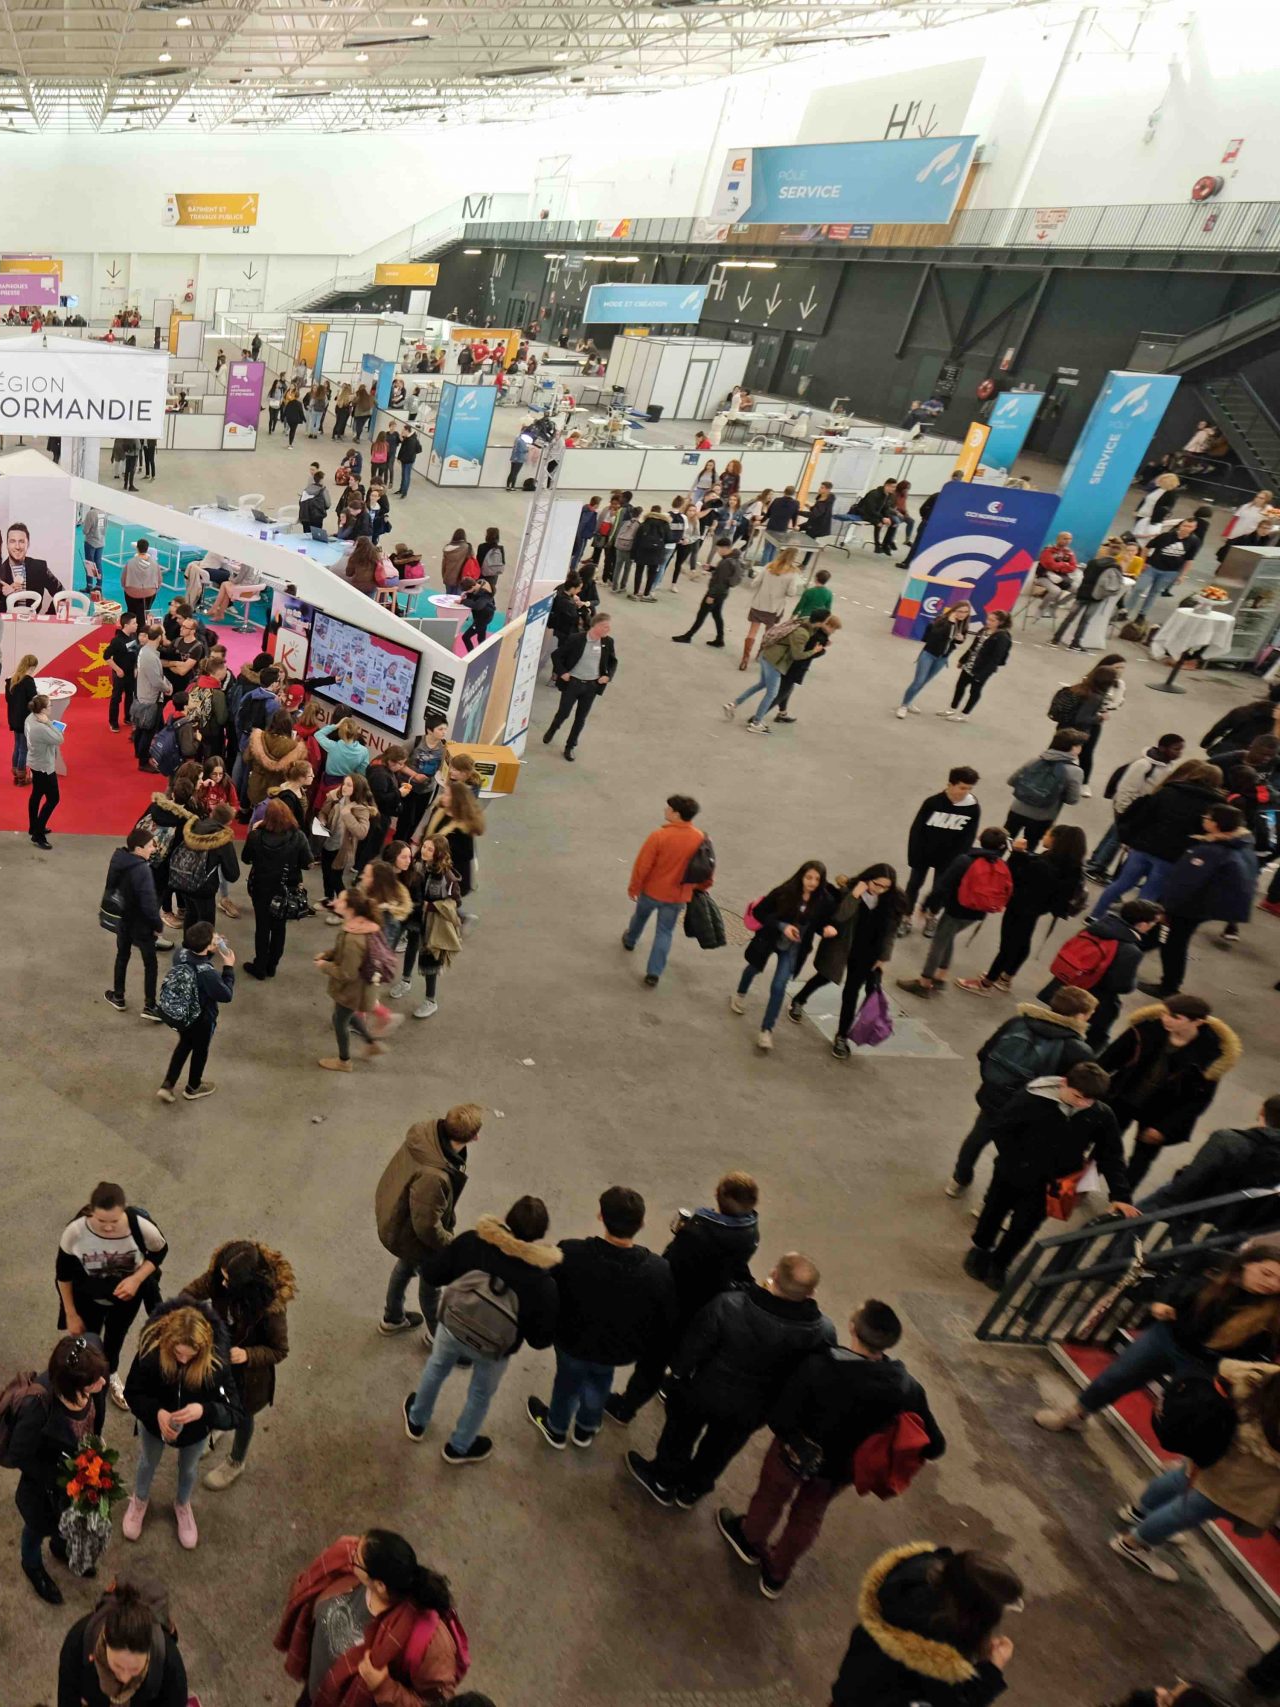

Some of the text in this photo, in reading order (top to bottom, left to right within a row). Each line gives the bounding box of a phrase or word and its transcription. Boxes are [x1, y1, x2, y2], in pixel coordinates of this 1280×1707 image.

[778, 185, 842, 199] SERVICE
[1089, 432, 1122, 485] SERVICE
[926, 811, 971, 831] NIKE
